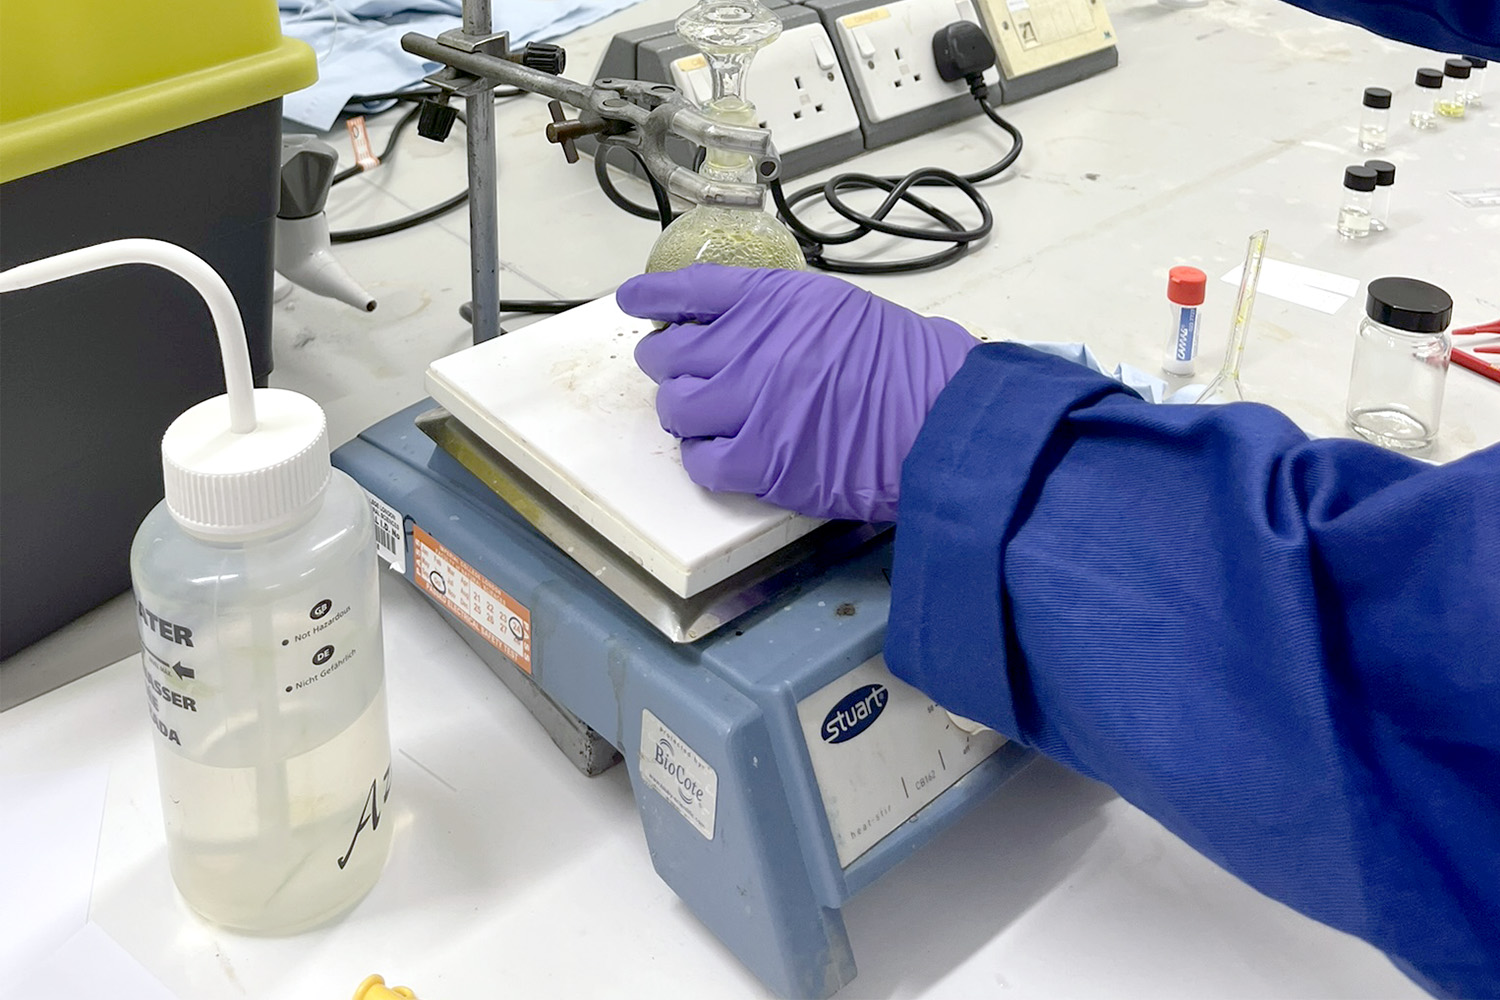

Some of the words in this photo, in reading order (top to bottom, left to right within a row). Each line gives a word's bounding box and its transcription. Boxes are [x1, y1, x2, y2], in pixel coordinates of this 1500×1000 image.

[139, 601, 195, 647] ATER
[294, 632, 312, 643] Not
[312, 605, 352, 636] Hazardous
[313, 602, 329, 617] GB
[295, 674, 319, 691] Nicht
[320, 648, 357, 678] Gefährlich
[317, 651, 331, 661] DE
[143, 671, 197, 712] ASSER
[825, 685, 886, 743] stuart
[655, 743, 704, 802] BioCote
[915, 769, 937, 791] CB162
[850, 804, 892, 840] heat-stir
